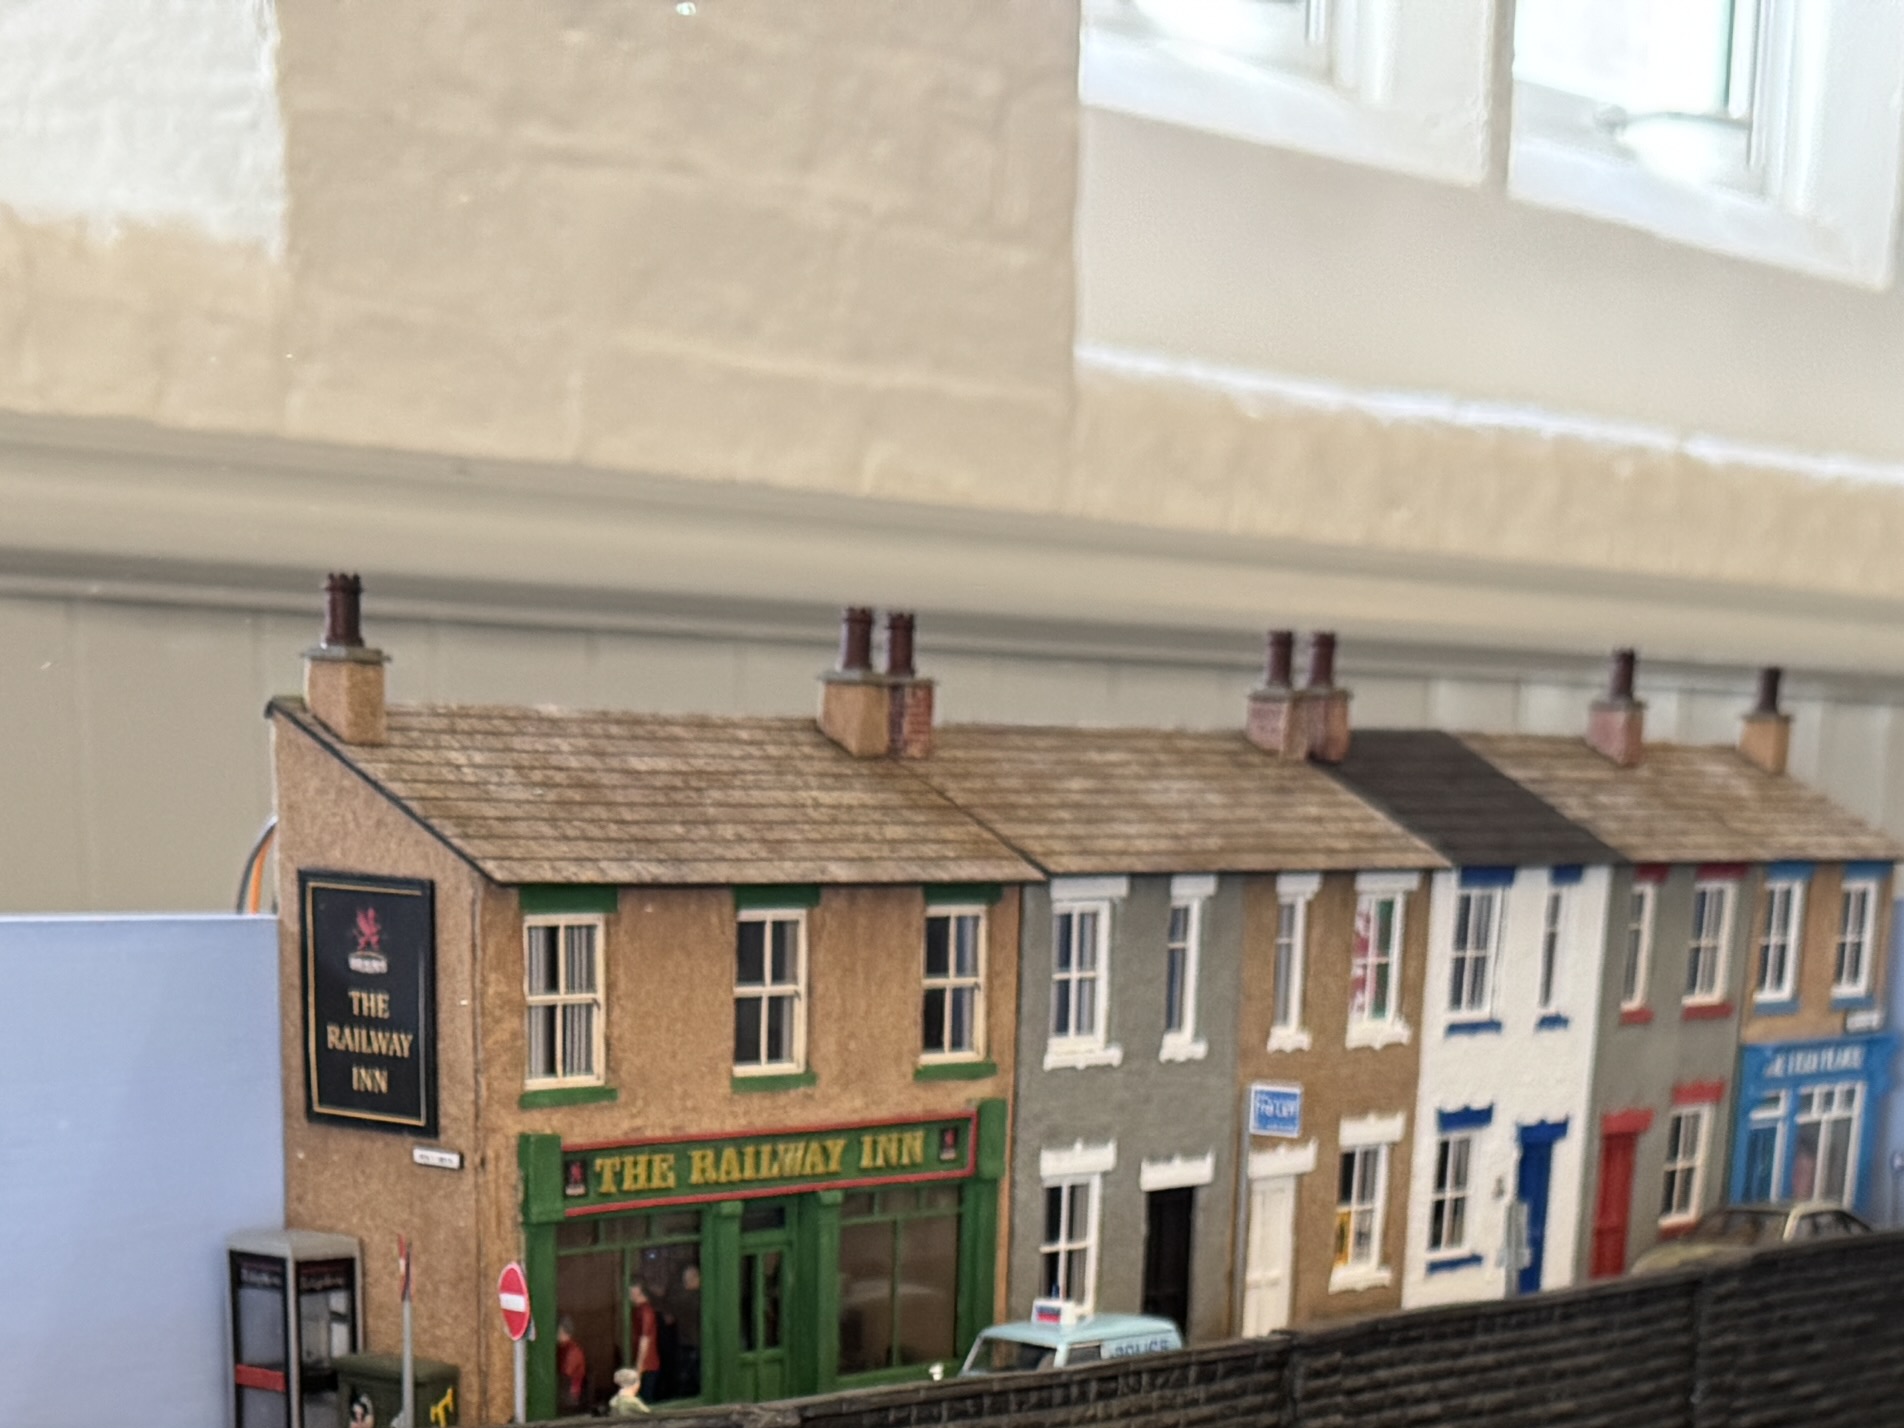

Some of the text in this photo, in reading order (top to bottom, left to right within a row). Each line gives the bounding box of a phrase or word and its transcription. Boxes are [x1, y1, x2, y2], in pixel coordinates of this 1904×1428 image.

[348, 990, 391, 1019] THE
[326, 1024, 414, 1058] RAILWAY
[352, 1065, 389, 1094] INN
[594, 1131, 925, 1194] THE RAILWAY INN
